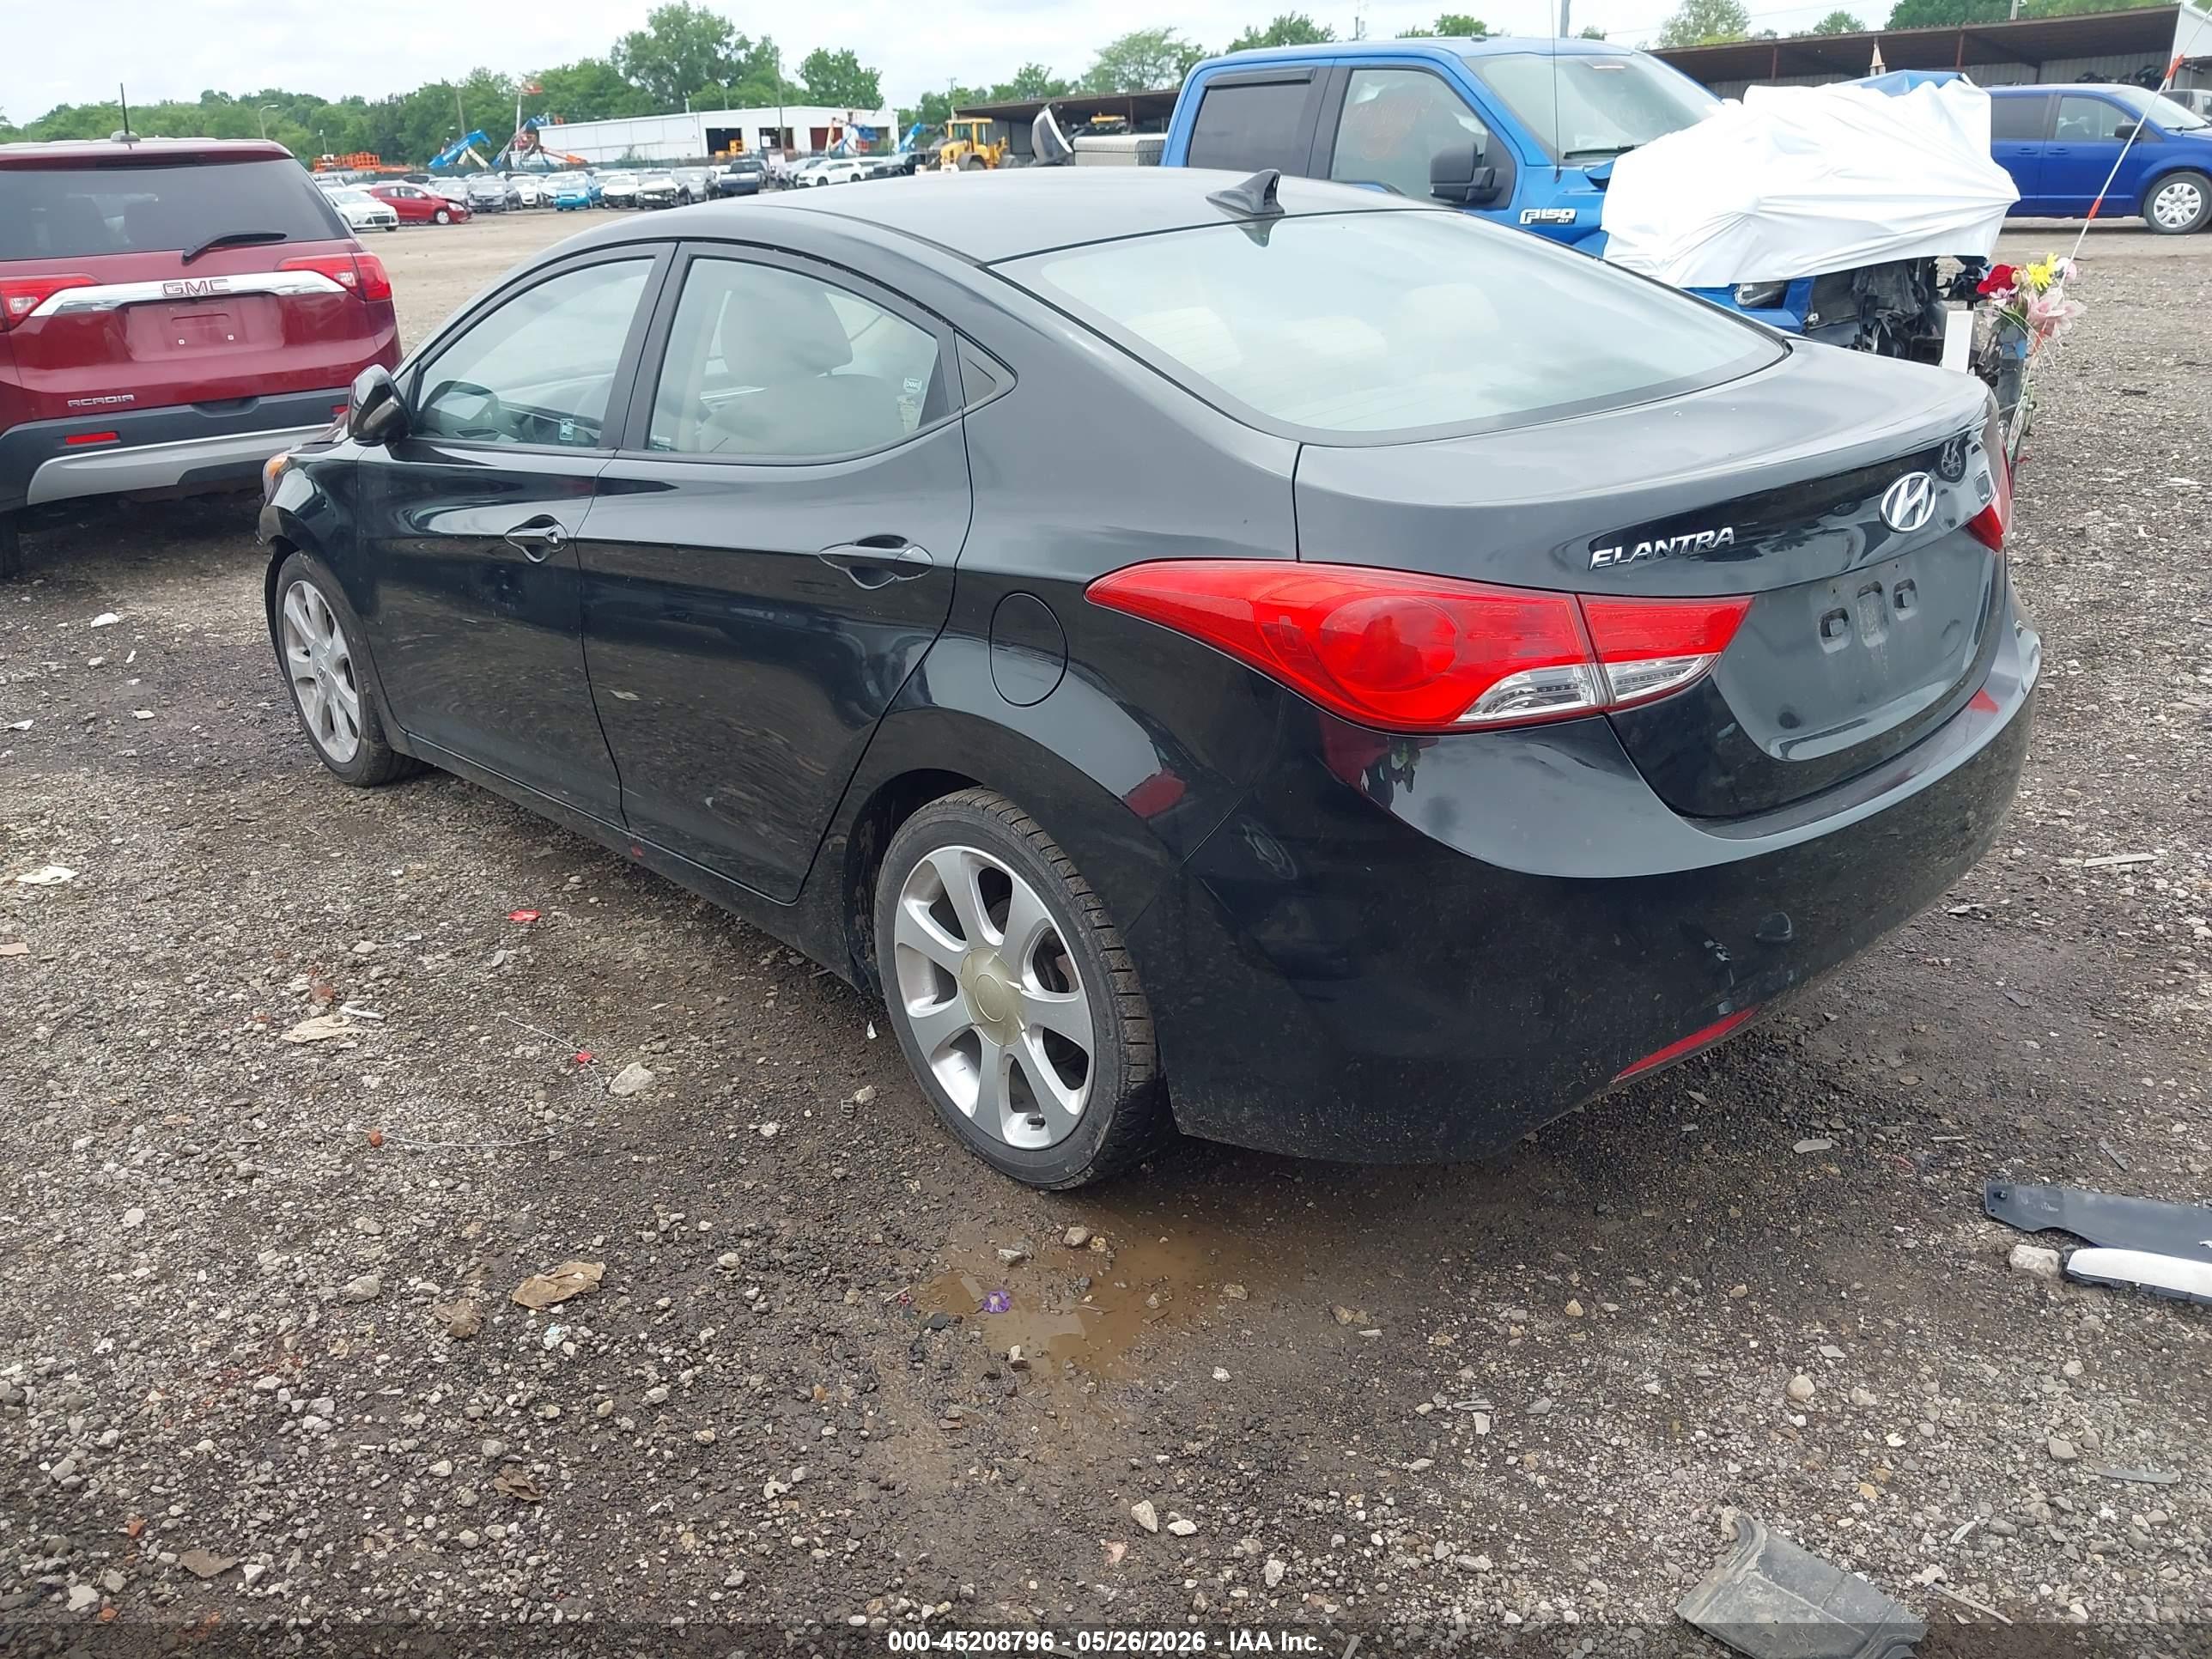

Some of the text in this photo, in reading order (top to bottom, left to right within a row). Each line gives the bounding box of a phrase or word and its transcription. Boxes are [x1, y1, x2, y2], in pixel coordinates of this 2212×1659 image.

[1519, 208, 1577, 224] F150
[162, 278, 230, 297] GMC
[67, 394, 135, 407] ACADIA
[1588, 526, 1735, 570] ELANTRA
